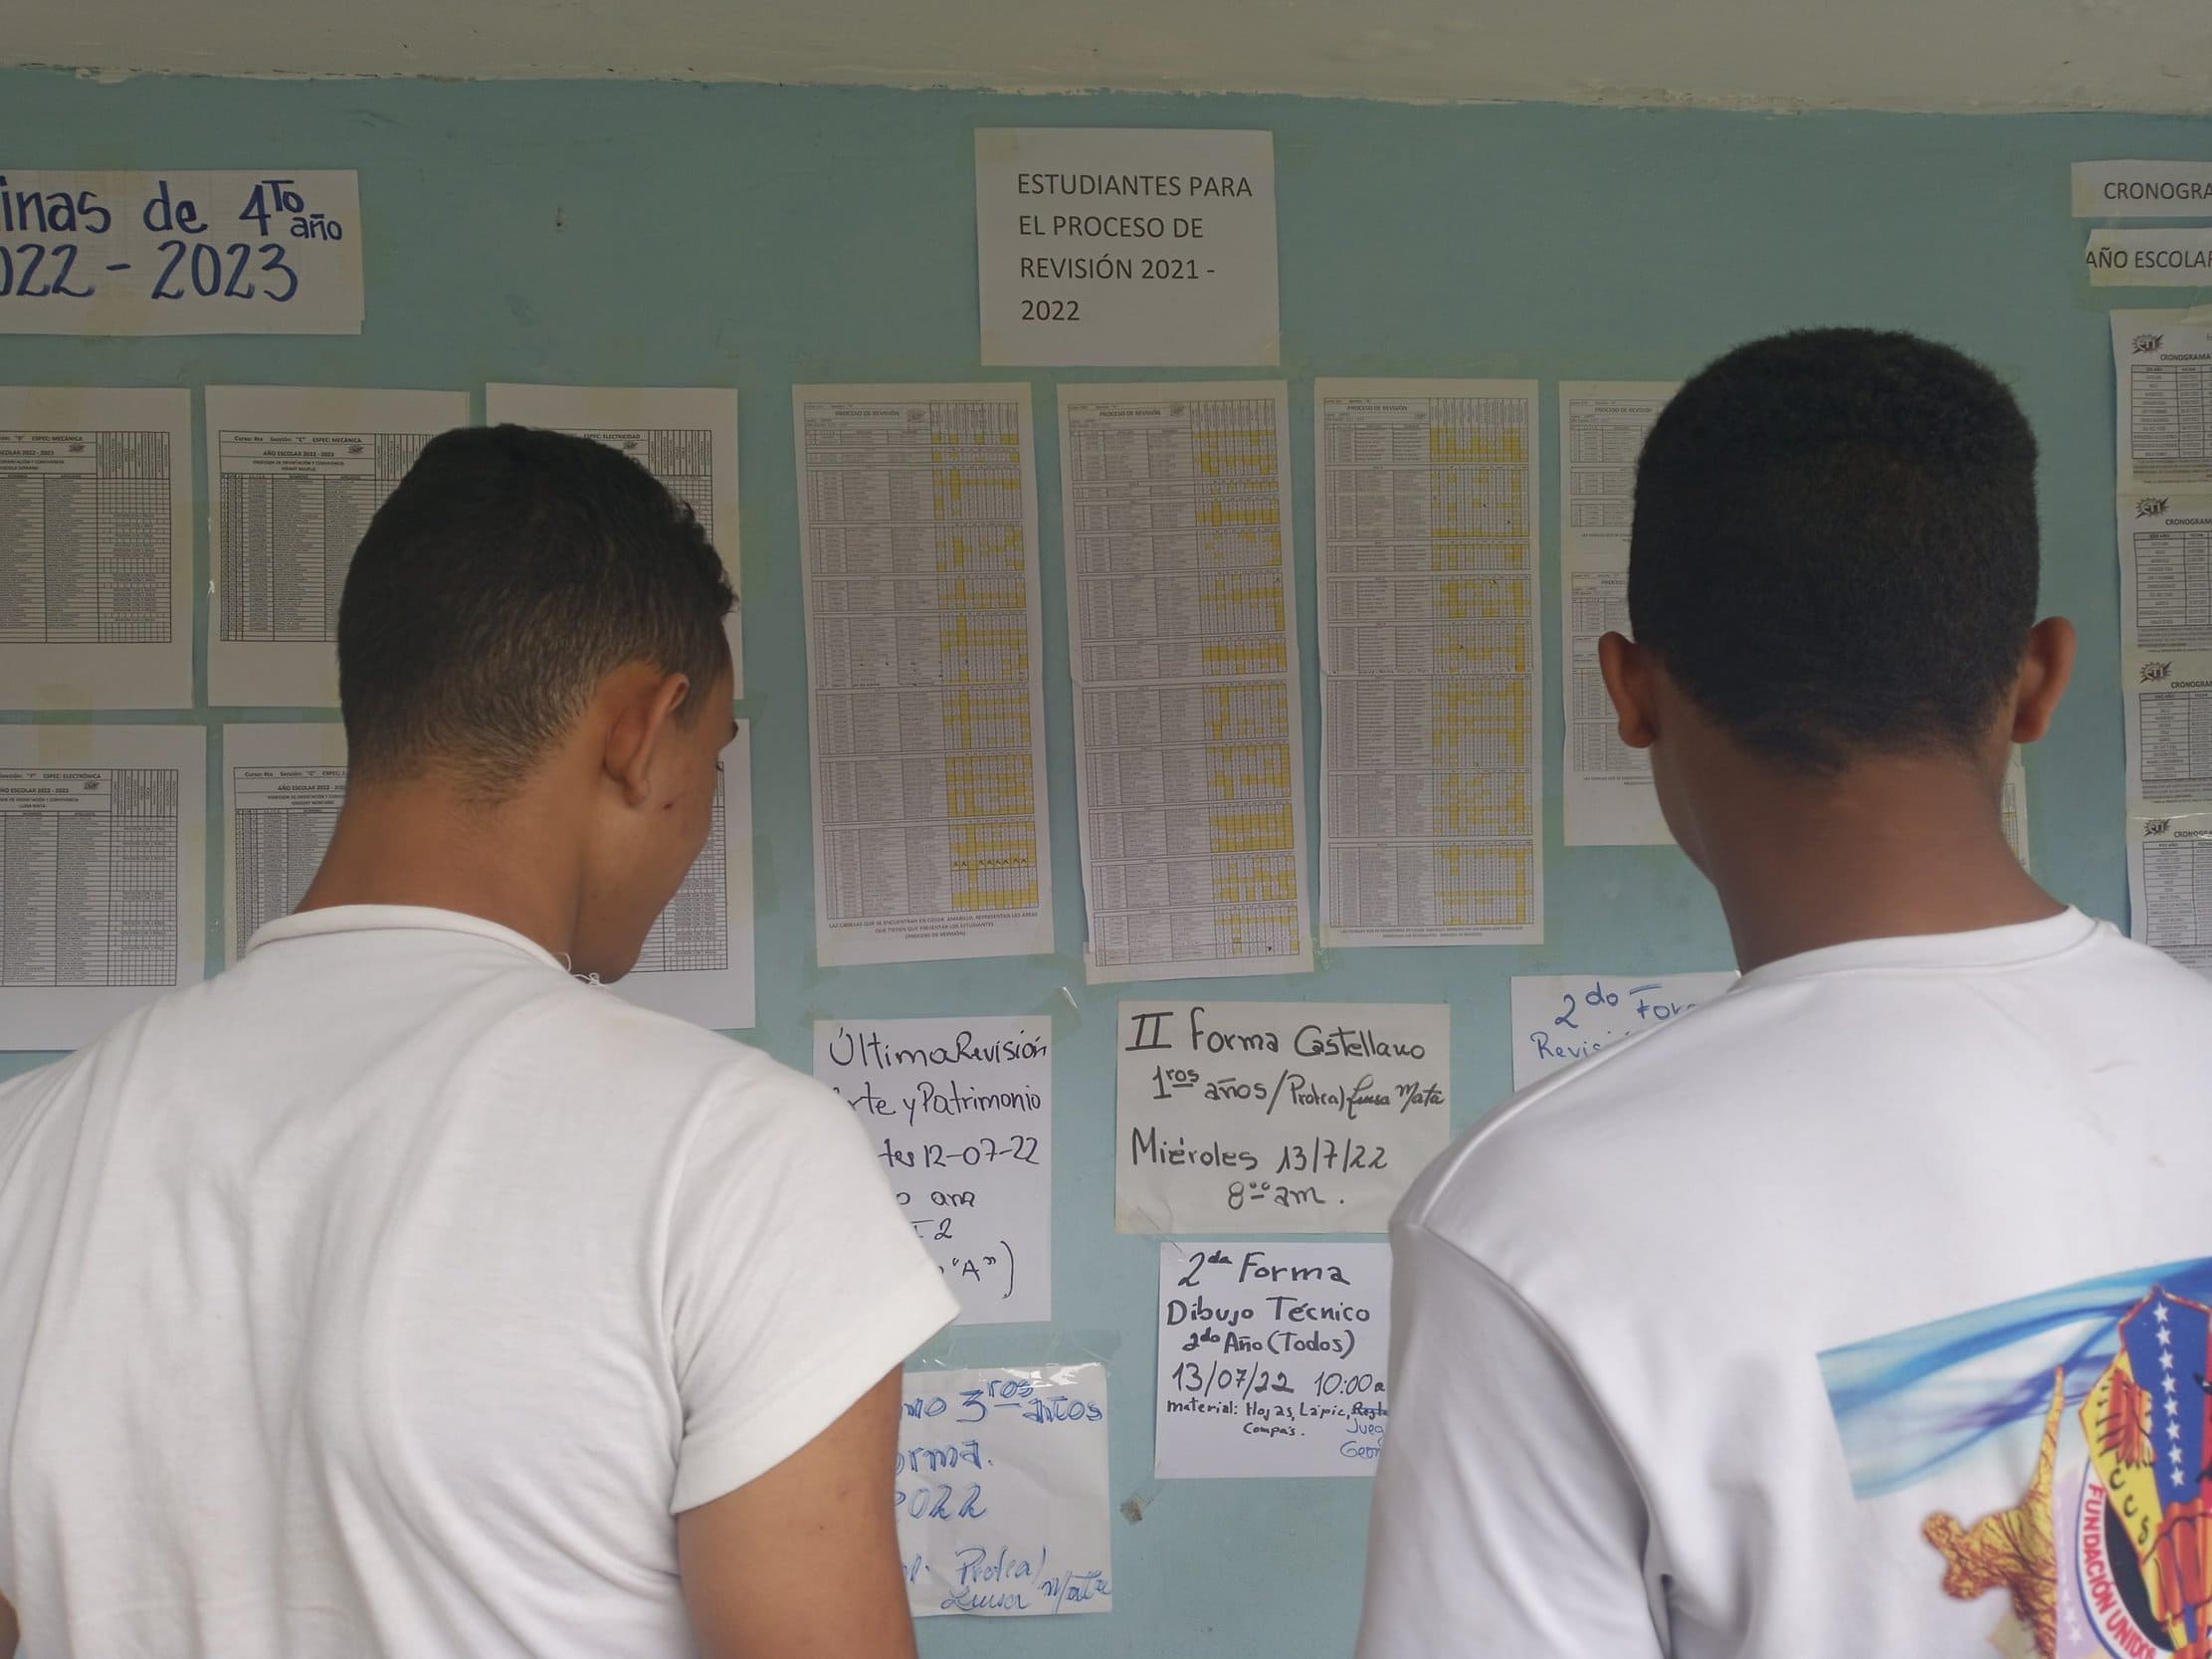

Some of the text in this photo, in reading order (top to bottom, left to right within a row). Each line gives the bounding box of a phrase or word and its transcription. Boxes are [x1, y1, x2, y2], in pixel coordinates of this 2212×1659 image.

[1017, 173, 1254, 197] ESTUDIANTES PARA
[143, 180, 208, 234] de
[290, 212, 343, 241] año
[1019, 215, 1204, 238] EL PROCESO DE
[151, 240, 300, 303] 2023
[1020, 253, 1133, 280] REVISIÓN
[1140, 259, 1200, 280] 2021
[2086, 246, 2129, 269] AÑO
[1021, 300, 1082, 320] 2022
[829, 1026, 1049, 1070] Última Revisión
[1125, 1011, 1174, 1051] II
[833, 1080, 1042, 1127] rte y Patrimonio
[923, 1135, 1042, 1168] 12-07-22
[1275, 1137, 1389, 1174] 13/7/22
[1177, 1249, 1351, 1288] 2da Forma
[1165, 1295, 1371, 1327] Dibujo Técnico
[1181, 1326, 1356, 1360] 2do Año (Todos)
[1171, 1359, 1295, 1401] 13/07/22
[1166, 1396, 1239, 1416] material:
[2084, 1483, 2118, 1615] FUNDACIÓN
